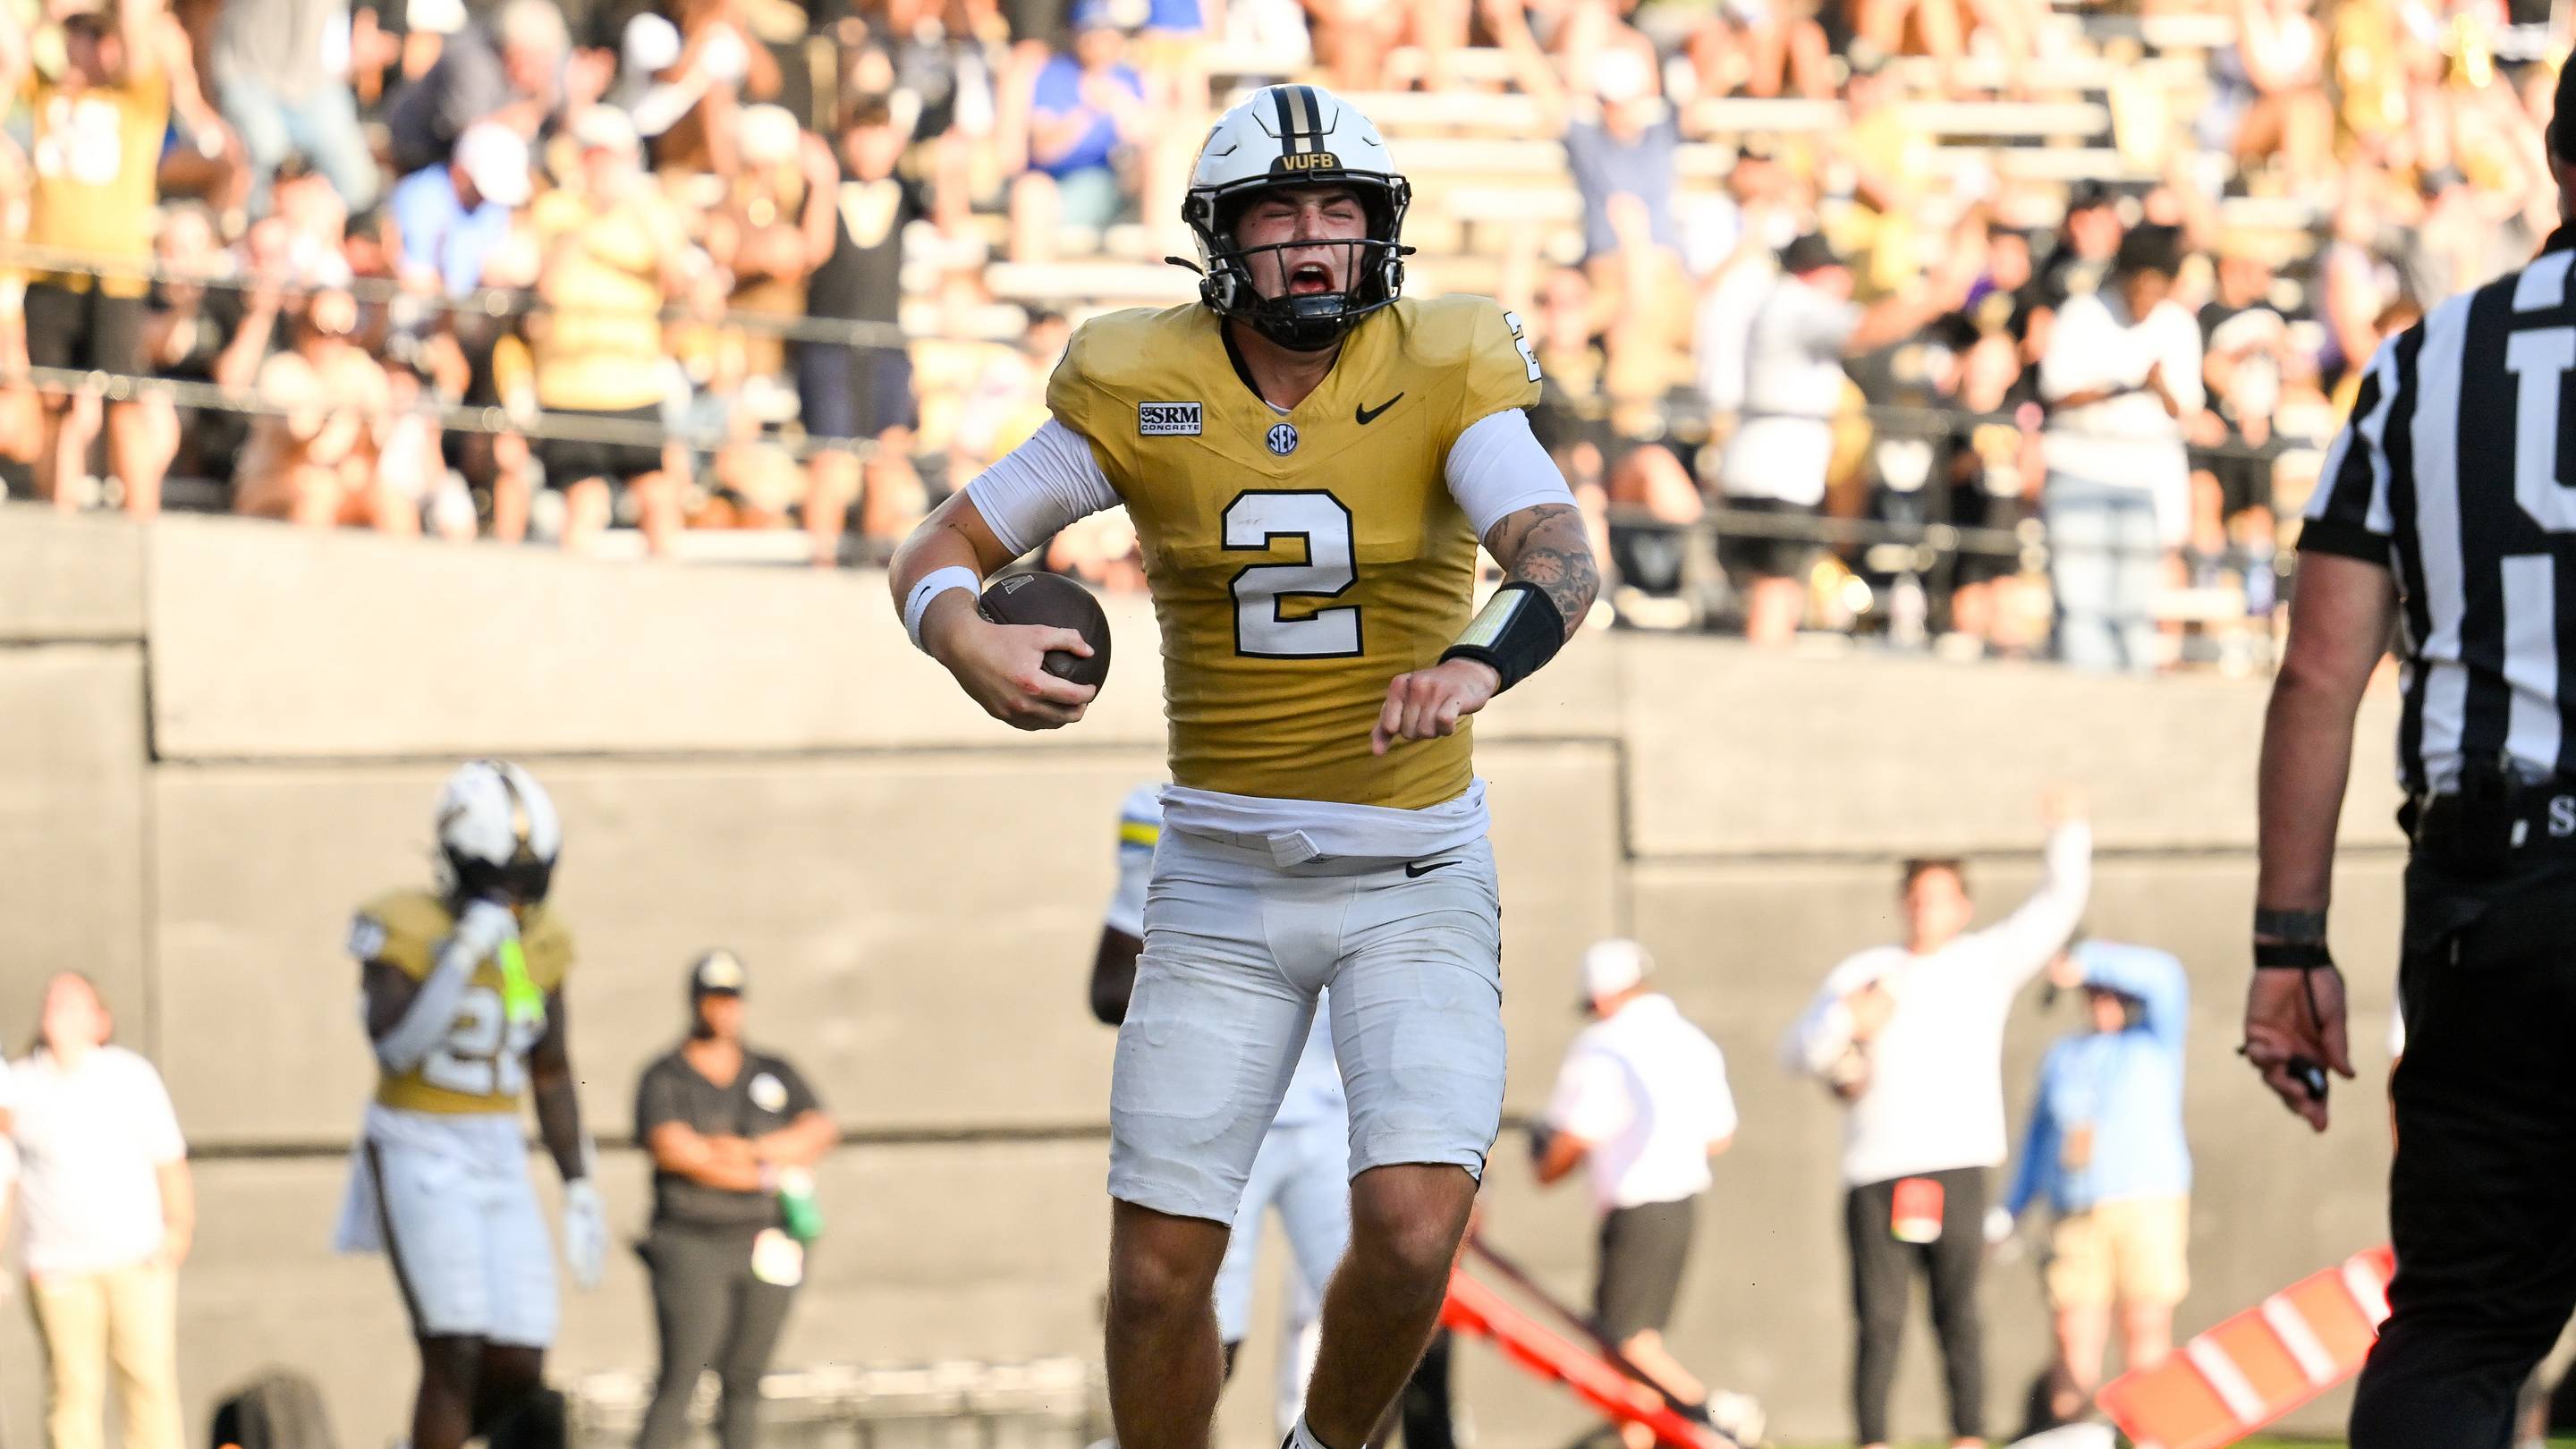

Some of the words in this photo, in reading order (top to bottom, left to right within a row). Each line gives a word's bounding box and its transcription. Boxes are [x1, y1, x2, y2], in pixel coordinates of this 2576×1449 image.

[1282, 153, 1334, 171] VUFB
[1151, 407, 1199, 423] SRM
[1268, 424, 1296, 453] SEC
[1221, 488, 1364, 659] 2
